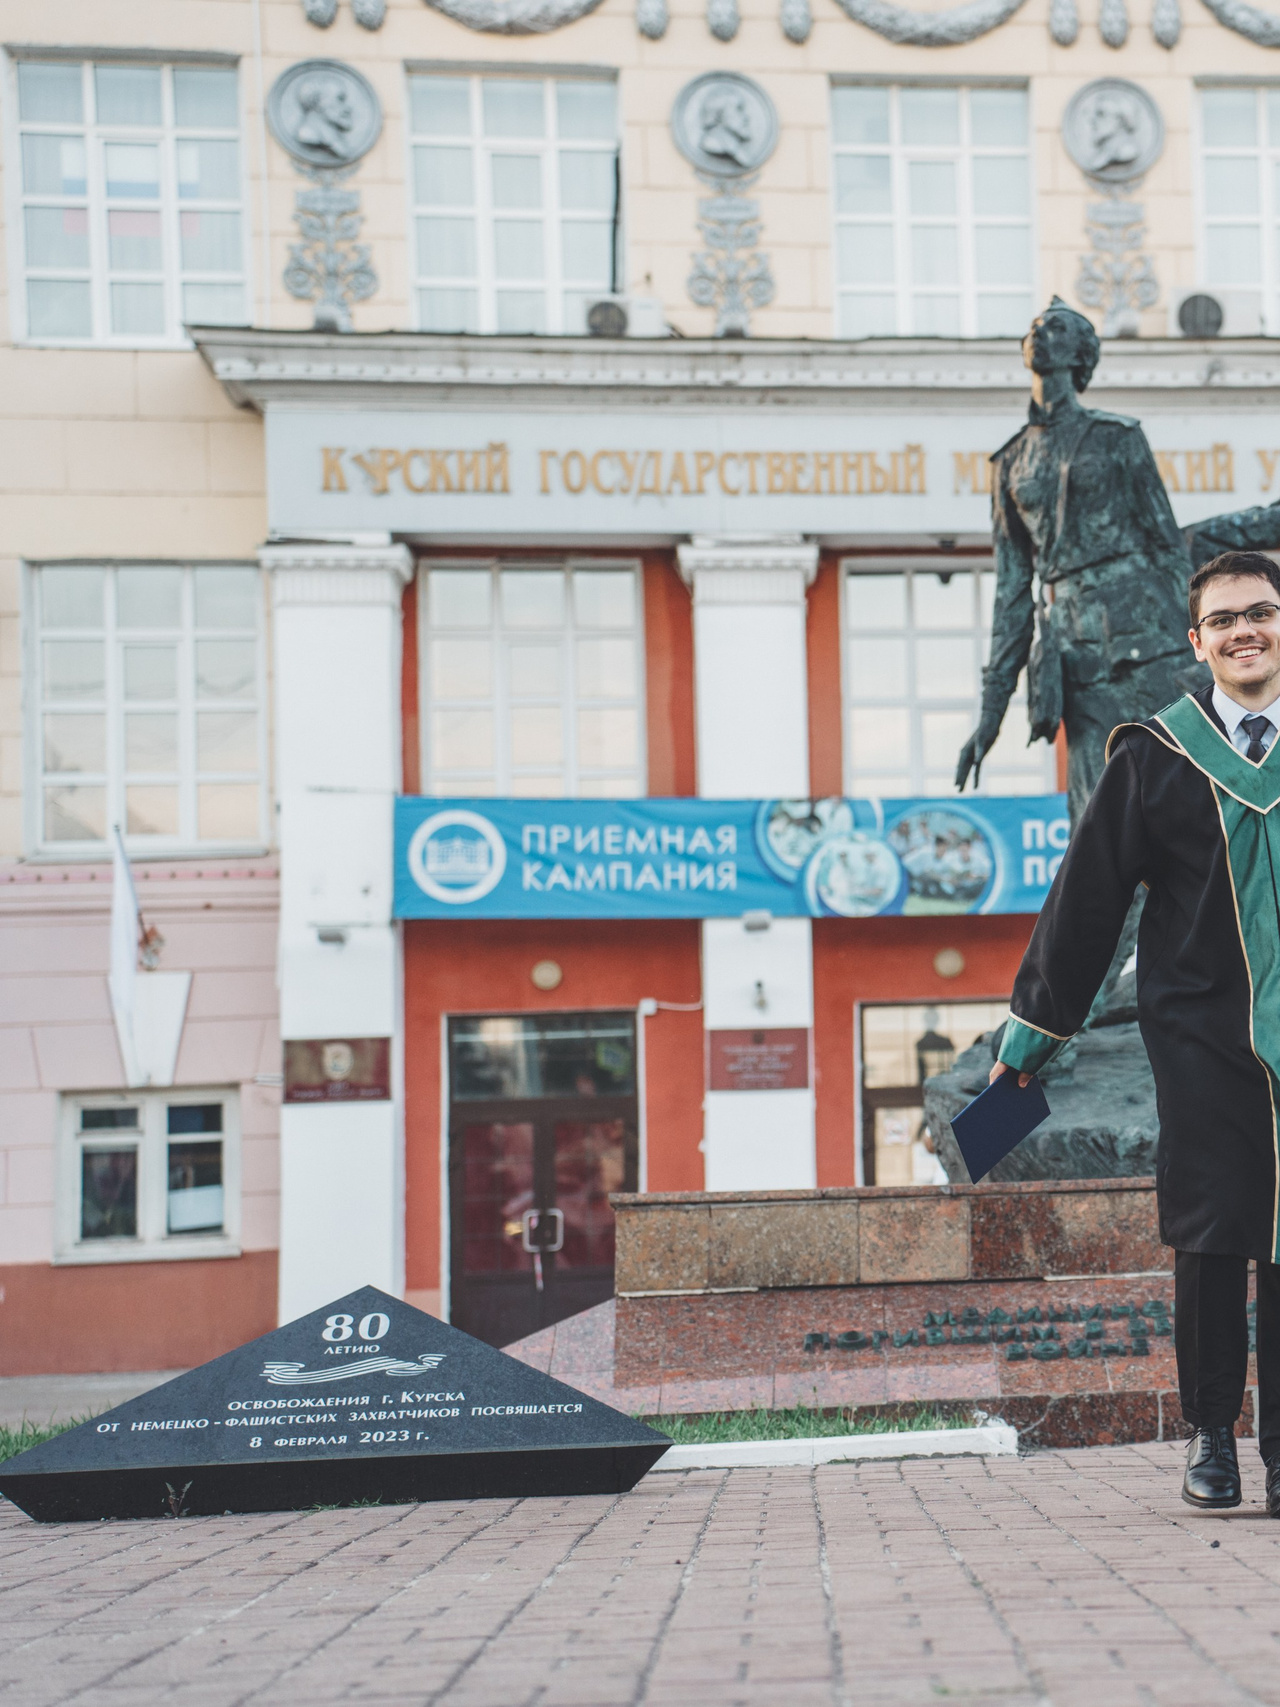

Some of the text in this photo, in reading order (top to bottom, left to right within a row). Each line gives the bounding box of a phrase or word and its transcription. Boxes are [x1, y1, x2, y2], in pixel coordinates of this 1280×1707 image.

[320, 443, 512, 494] КУРСКИЙ
[539, 444, 928, 501] ГОСУДАРСТВЕННЫЙ
[522, 823, 738, 856] ПРИЕМНАЯ
[522, 860, 738, 893] КАМПАНИЯ
[322, 1313, 390, 1341] 80
[324, 1344, 381, 1355] ЛЕТИЮ
[227, 1395, 371, 1411] ОСВОБОЖДЕНИЯ
[96, 1422, 121, 1433] ОТ
[348, 1407, 461, 1422] ЗАХВАТЧИКОВ
[249, 1436, 263, 1449] 8
[359, 1430, 410, 1444] 2023
